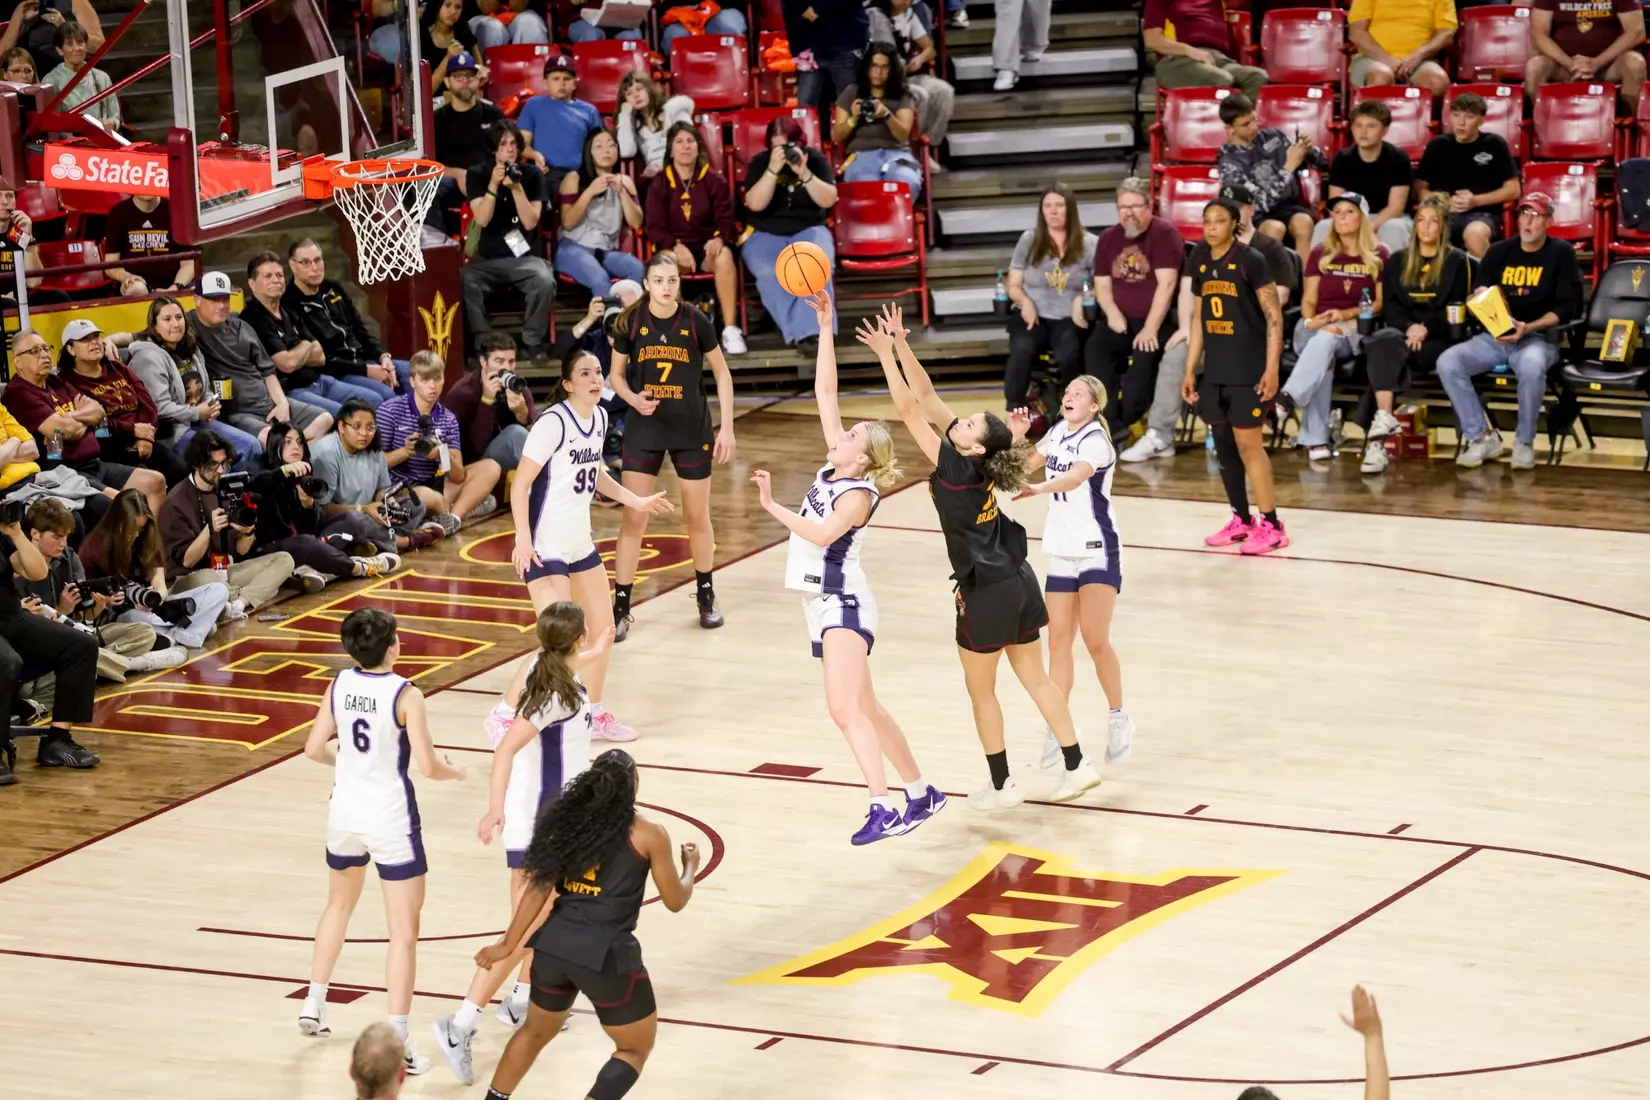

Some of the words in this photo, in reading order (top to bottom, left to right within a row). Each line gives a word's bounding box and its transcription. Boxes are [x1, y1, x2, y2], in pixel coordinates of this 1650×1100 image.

[86, 156, 142, 186] State
[144, 161, 169, 188] Fa
[129, 233, 145, 243] SUN
[147, 233, 169, 243] DEVIL
[1502, 265, 1543, 287] ROW
[1210, 296, 1223, 318] 0
[638, 345, 690, 363] ARIZONA
[656, 361, 673, 383] 7
[644, 383, 683, 399] STATE
[573, 467, 597, 494] 99
[344, 693, 377, 714] GARCIA
[352, 718, 371, 754] 6
